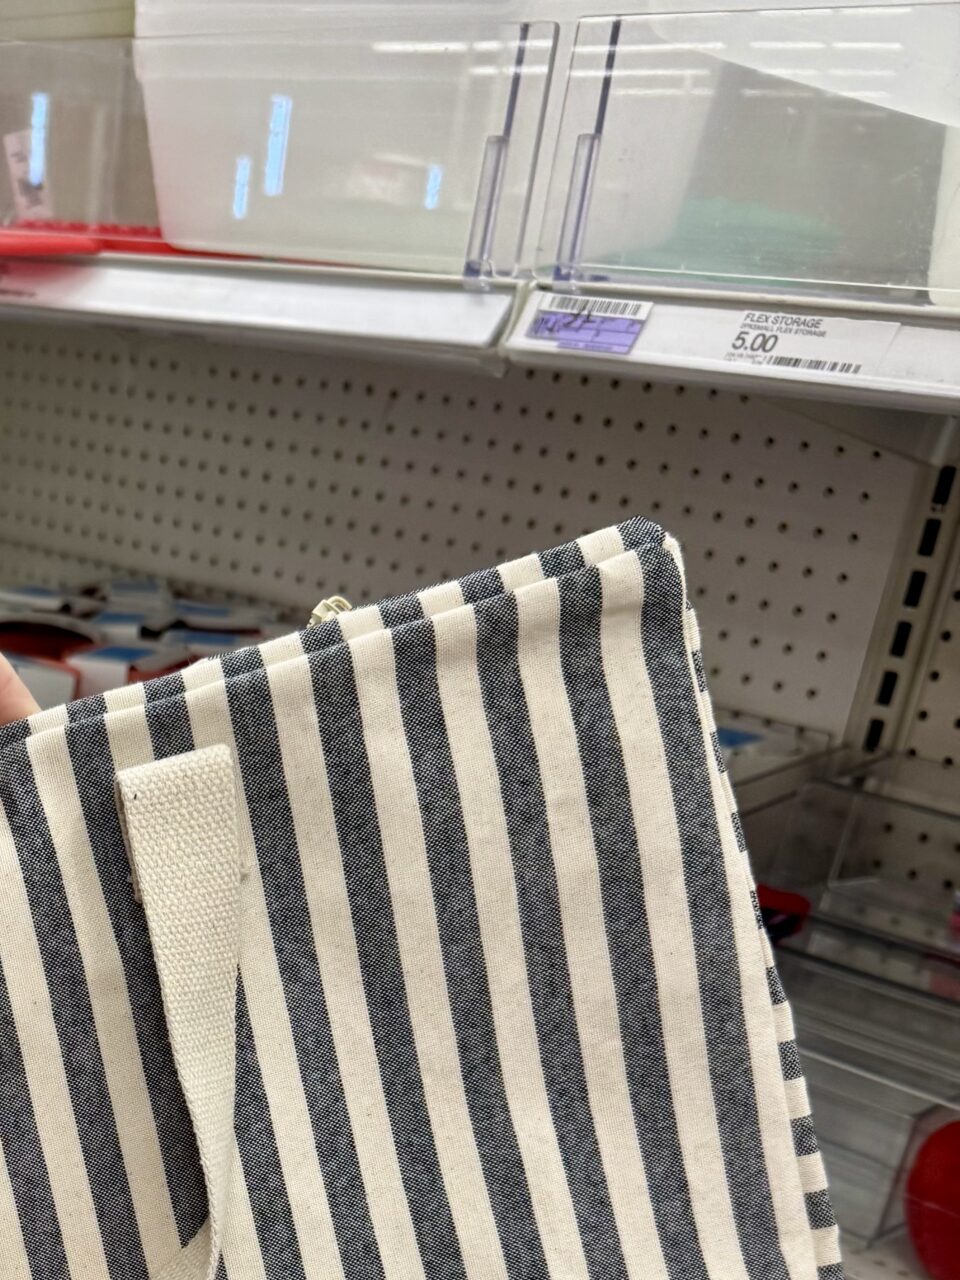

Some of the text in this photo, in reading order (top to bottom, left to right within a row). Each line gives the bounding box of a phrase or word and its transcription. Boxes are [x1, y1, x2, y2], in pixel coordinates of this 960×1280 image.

[743, 313, 824, 329] FLEX STORAGE
[731, 331, 778, 353] 5.00
